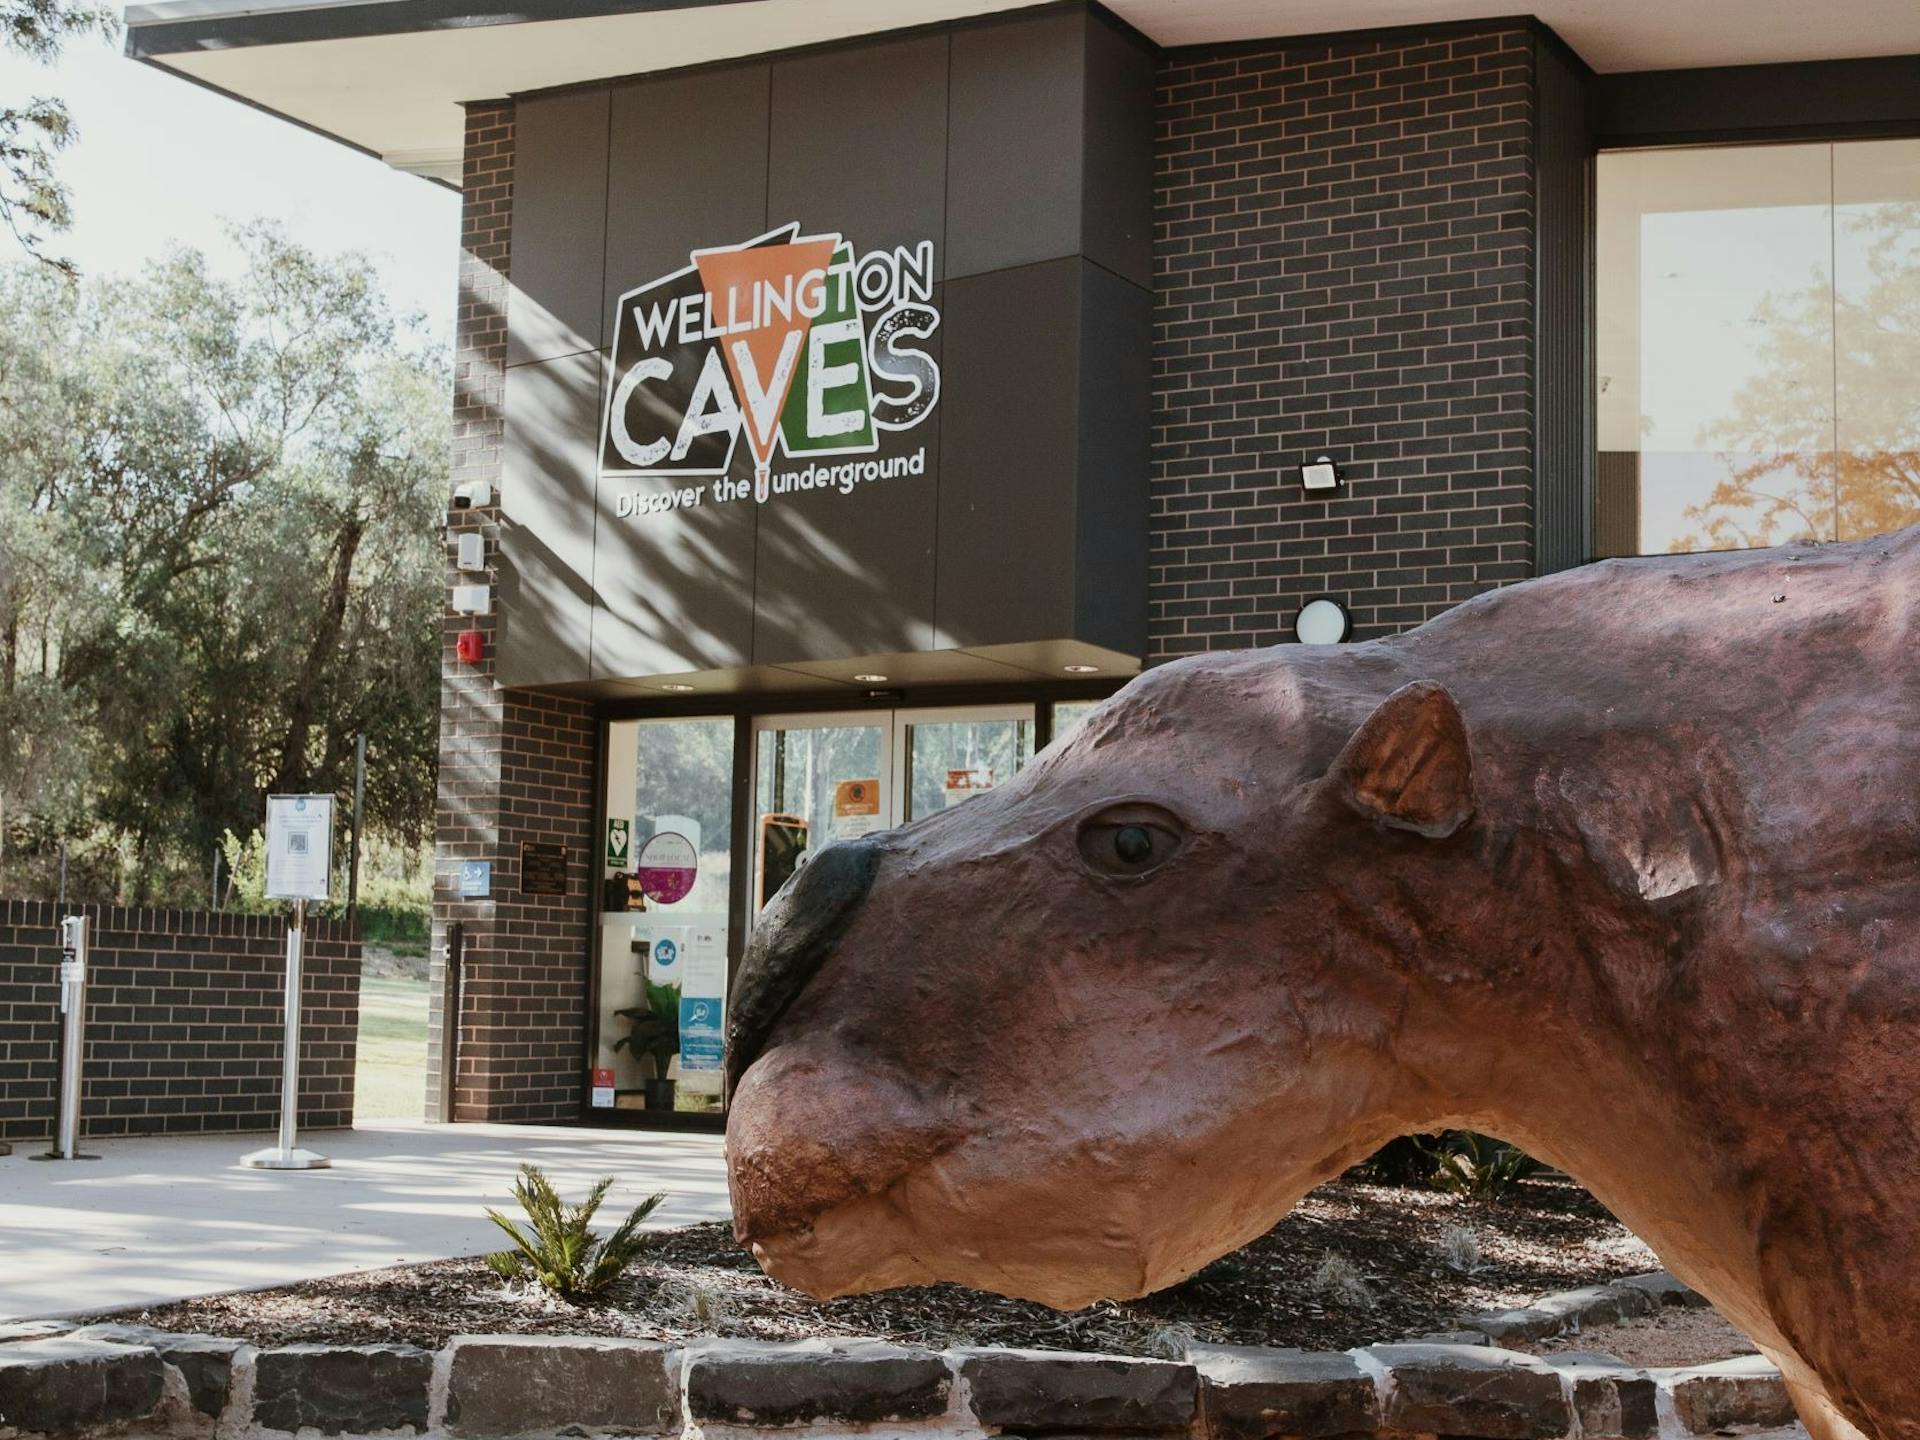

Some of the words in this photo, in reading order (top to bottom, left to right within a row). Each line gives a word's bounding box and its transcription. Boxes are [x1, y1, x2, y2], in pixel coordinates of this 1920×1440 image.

[633, 241, 933, 351] WELLINGTON
[610, 302, 940, 466] CAVES
[616, 485, 705, 518] Discover
[713, 477, 750, 502] the
[773, 448, 926, 494] underground
